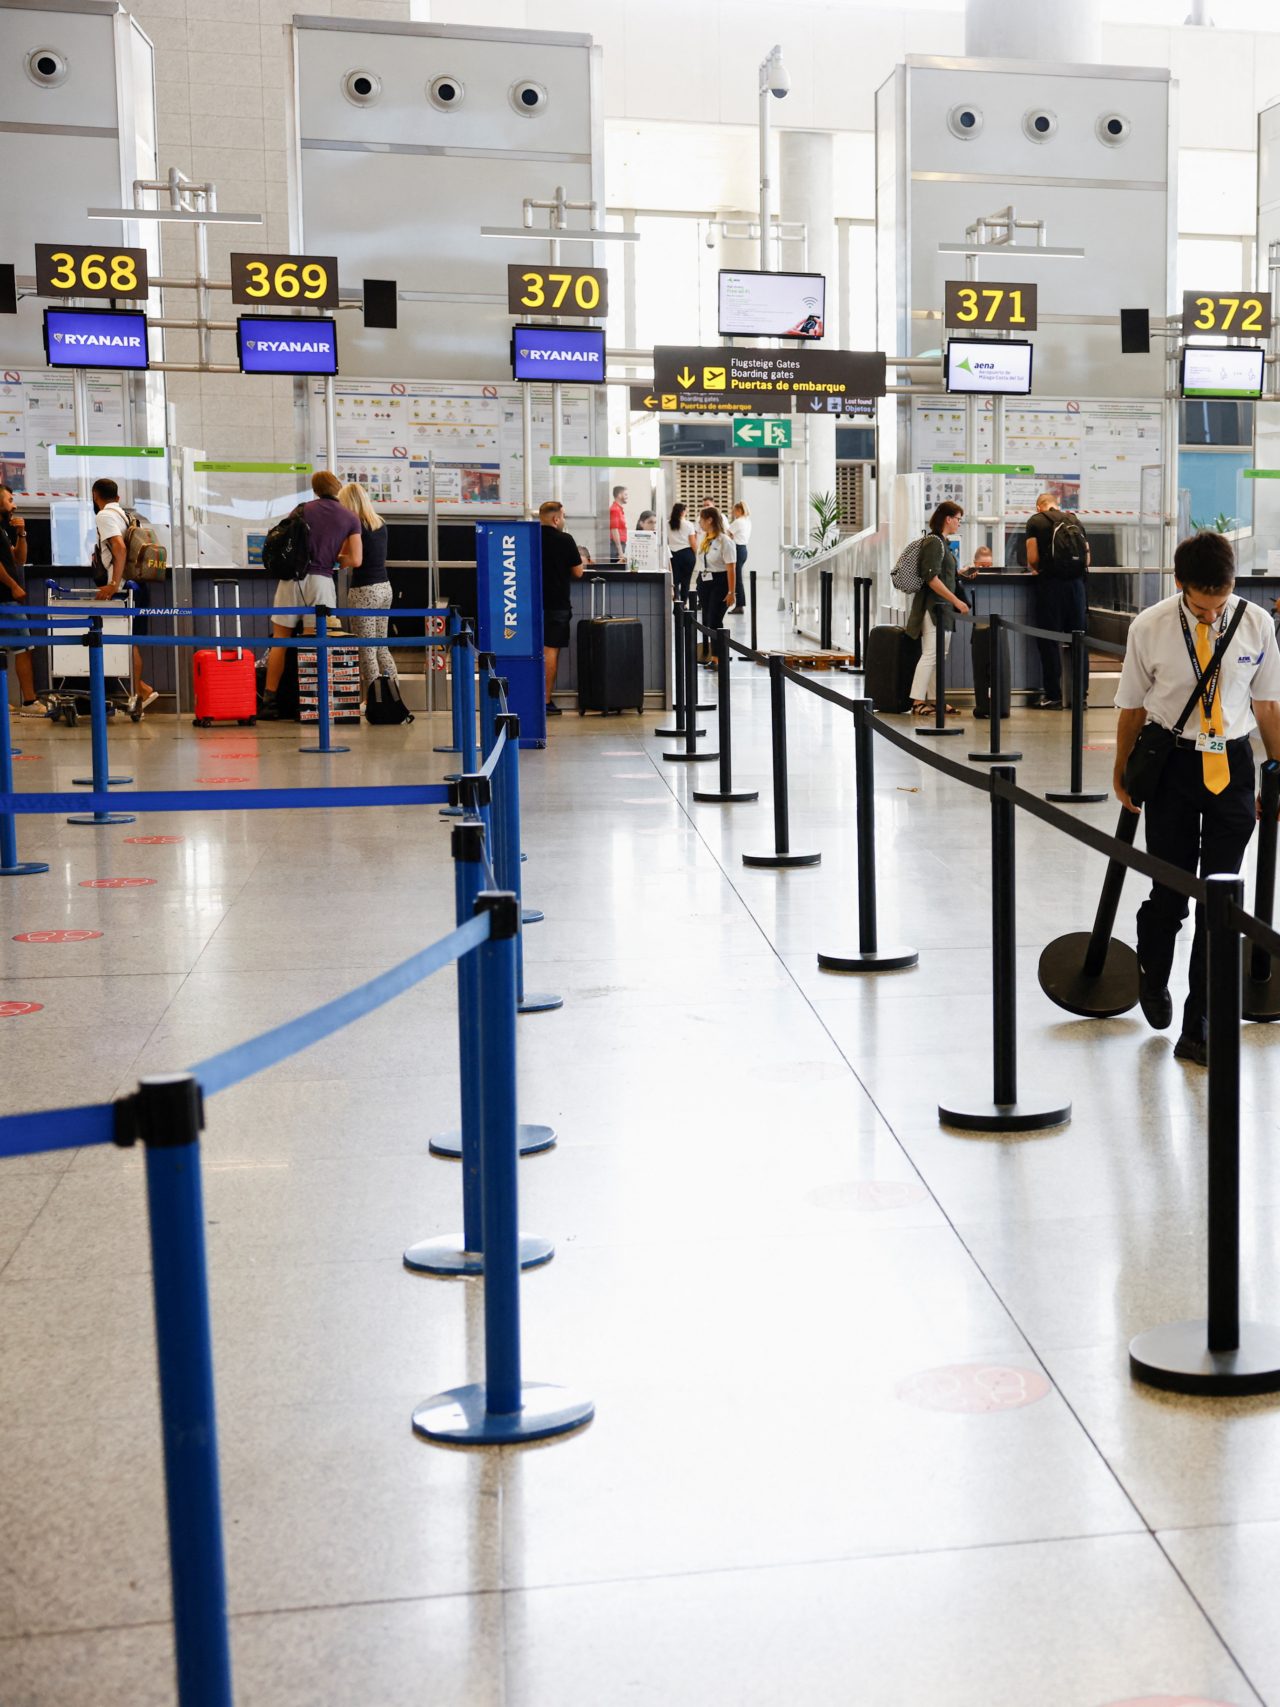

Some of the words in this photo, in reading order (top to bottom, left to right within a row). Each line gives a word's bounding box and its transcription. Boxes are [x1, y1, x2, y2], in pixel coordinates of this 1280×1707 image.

[50, 252, 138, 292] 368
[244, 261, 328, 299] 369
[520, 272, 600, 310] 370
[956, 288, 1026, 323] 371
[1193, 297, 1263, 331] 372
[64, 333, 141, 347] RYANAIR
[257, 340, 330, 353] RYANAIR
[530, 349, 599, 362] RYANAIR
[730, 358, 774, 370] Flugsteige
[776, 359, 801, 370] Gates
[974, 362, 995, 370] aena
[730, 369, 768, 380] Boarding
[770, 371, 794, 380] gates
[730, 380, 773, 391] Puertas
[776, 381, 790, 391] de
[792, 382, 846, 393] embarque
[680, 402, 707, 410] Puertas
[718, 403, 752, 411] embarque
[845, 405, 871, 413] Objetos
[147, 559, 168, 569] FAKE
[502, 535, 518, 626] RYANAIR
[1209, 741, 1224, 752] 25
